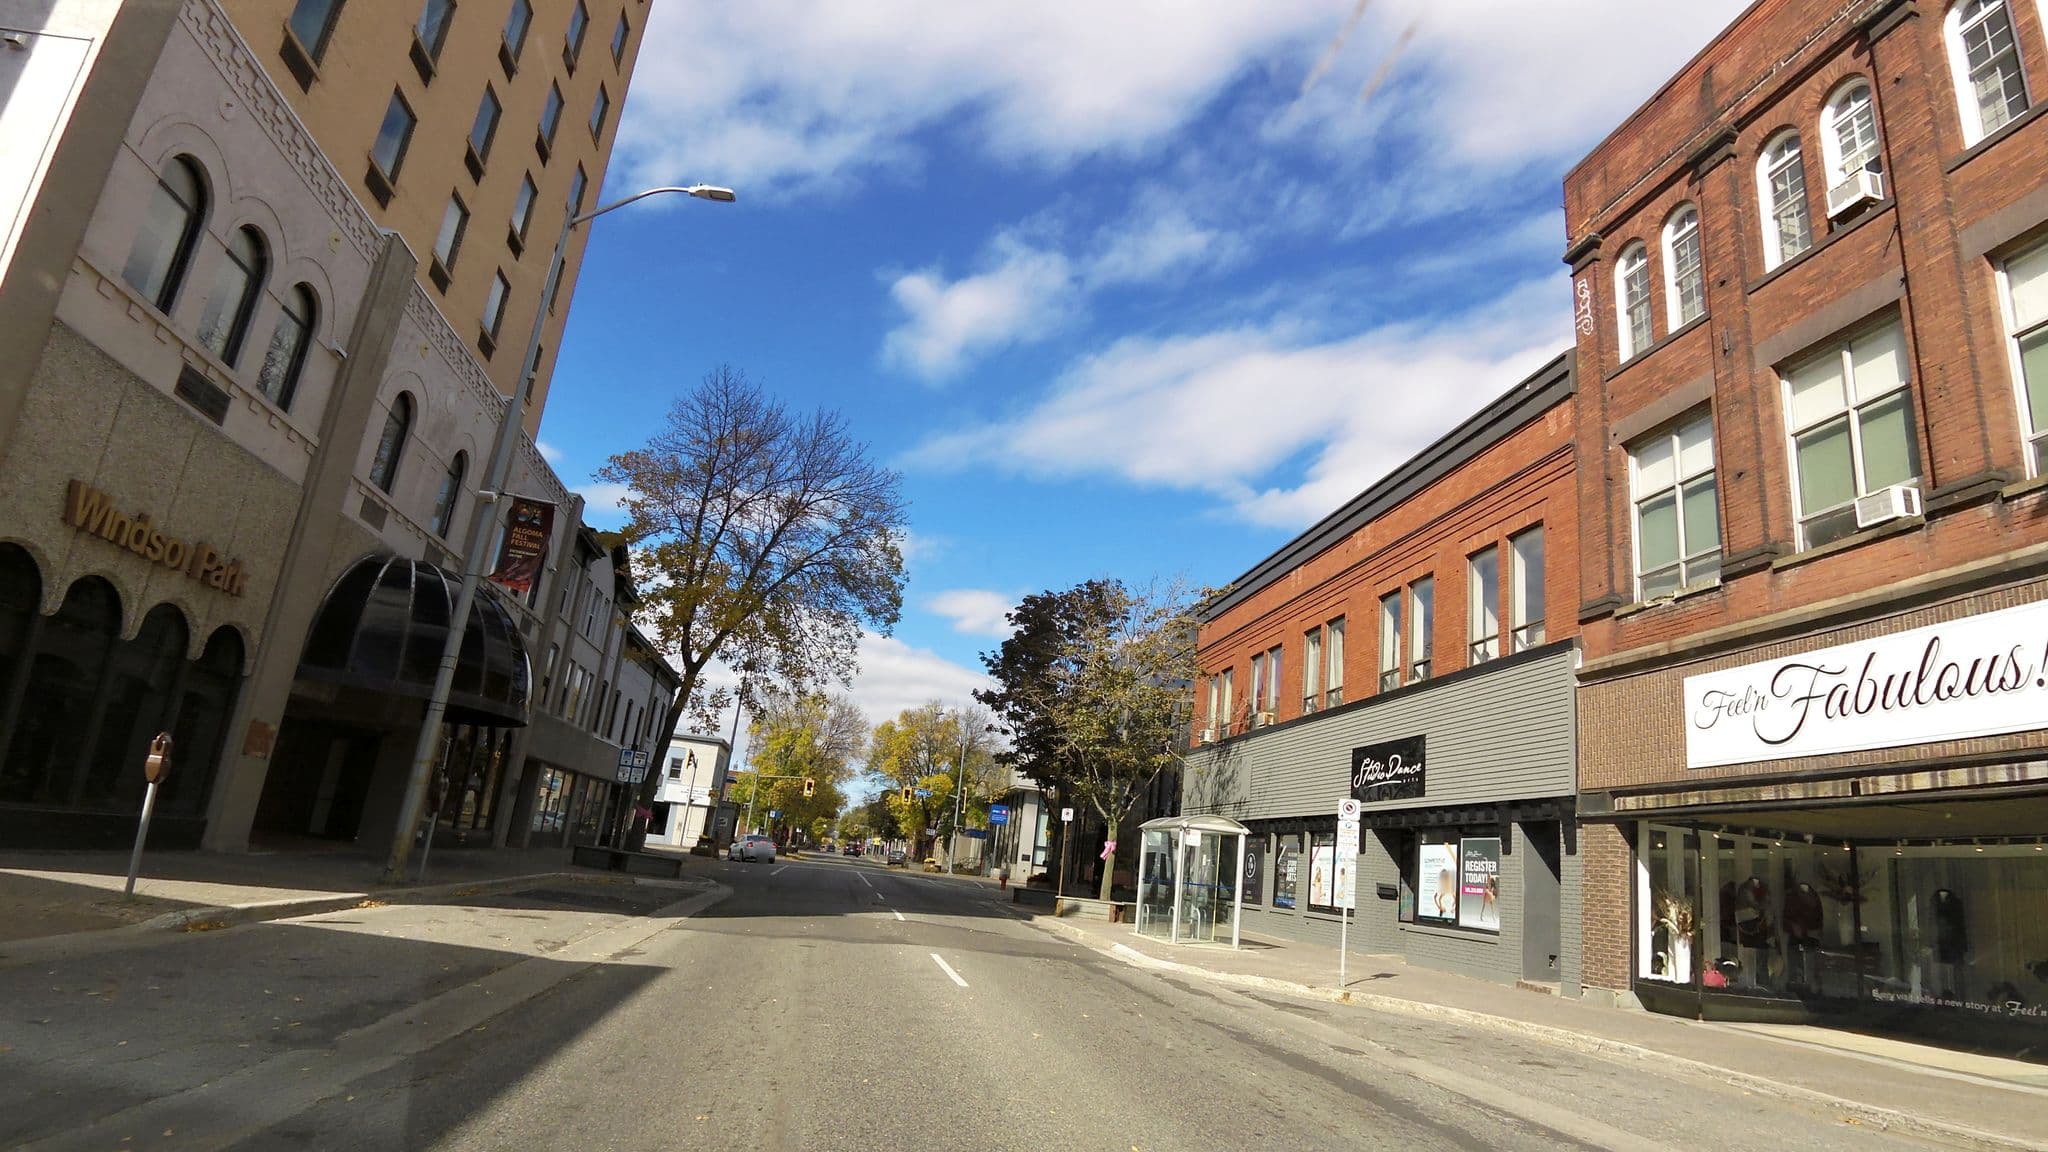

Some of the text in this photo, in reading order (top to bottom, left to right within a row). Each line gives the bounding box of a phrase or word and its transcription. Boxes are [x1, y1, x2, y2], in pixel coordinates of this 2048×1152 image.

[512, 533, 528, 541] FALL
[513, 527, 543, 537] ALGOMA
[66, 480, 248, 597] Windsor Park
[511, 540, 540, 549] FESTIVAL
[1387, 754, 1422, 780] Dance
[1465, 861, 1496, 872] REGISTER
[1465, 873, 1488, 883] TODAY!
[1937, 998, 1943, 1006] a
[1945, 1000, 1963, 1008] new
[1965, 1001, 1990, 1014] story
[1992, 1004, 2002, 1013] at
